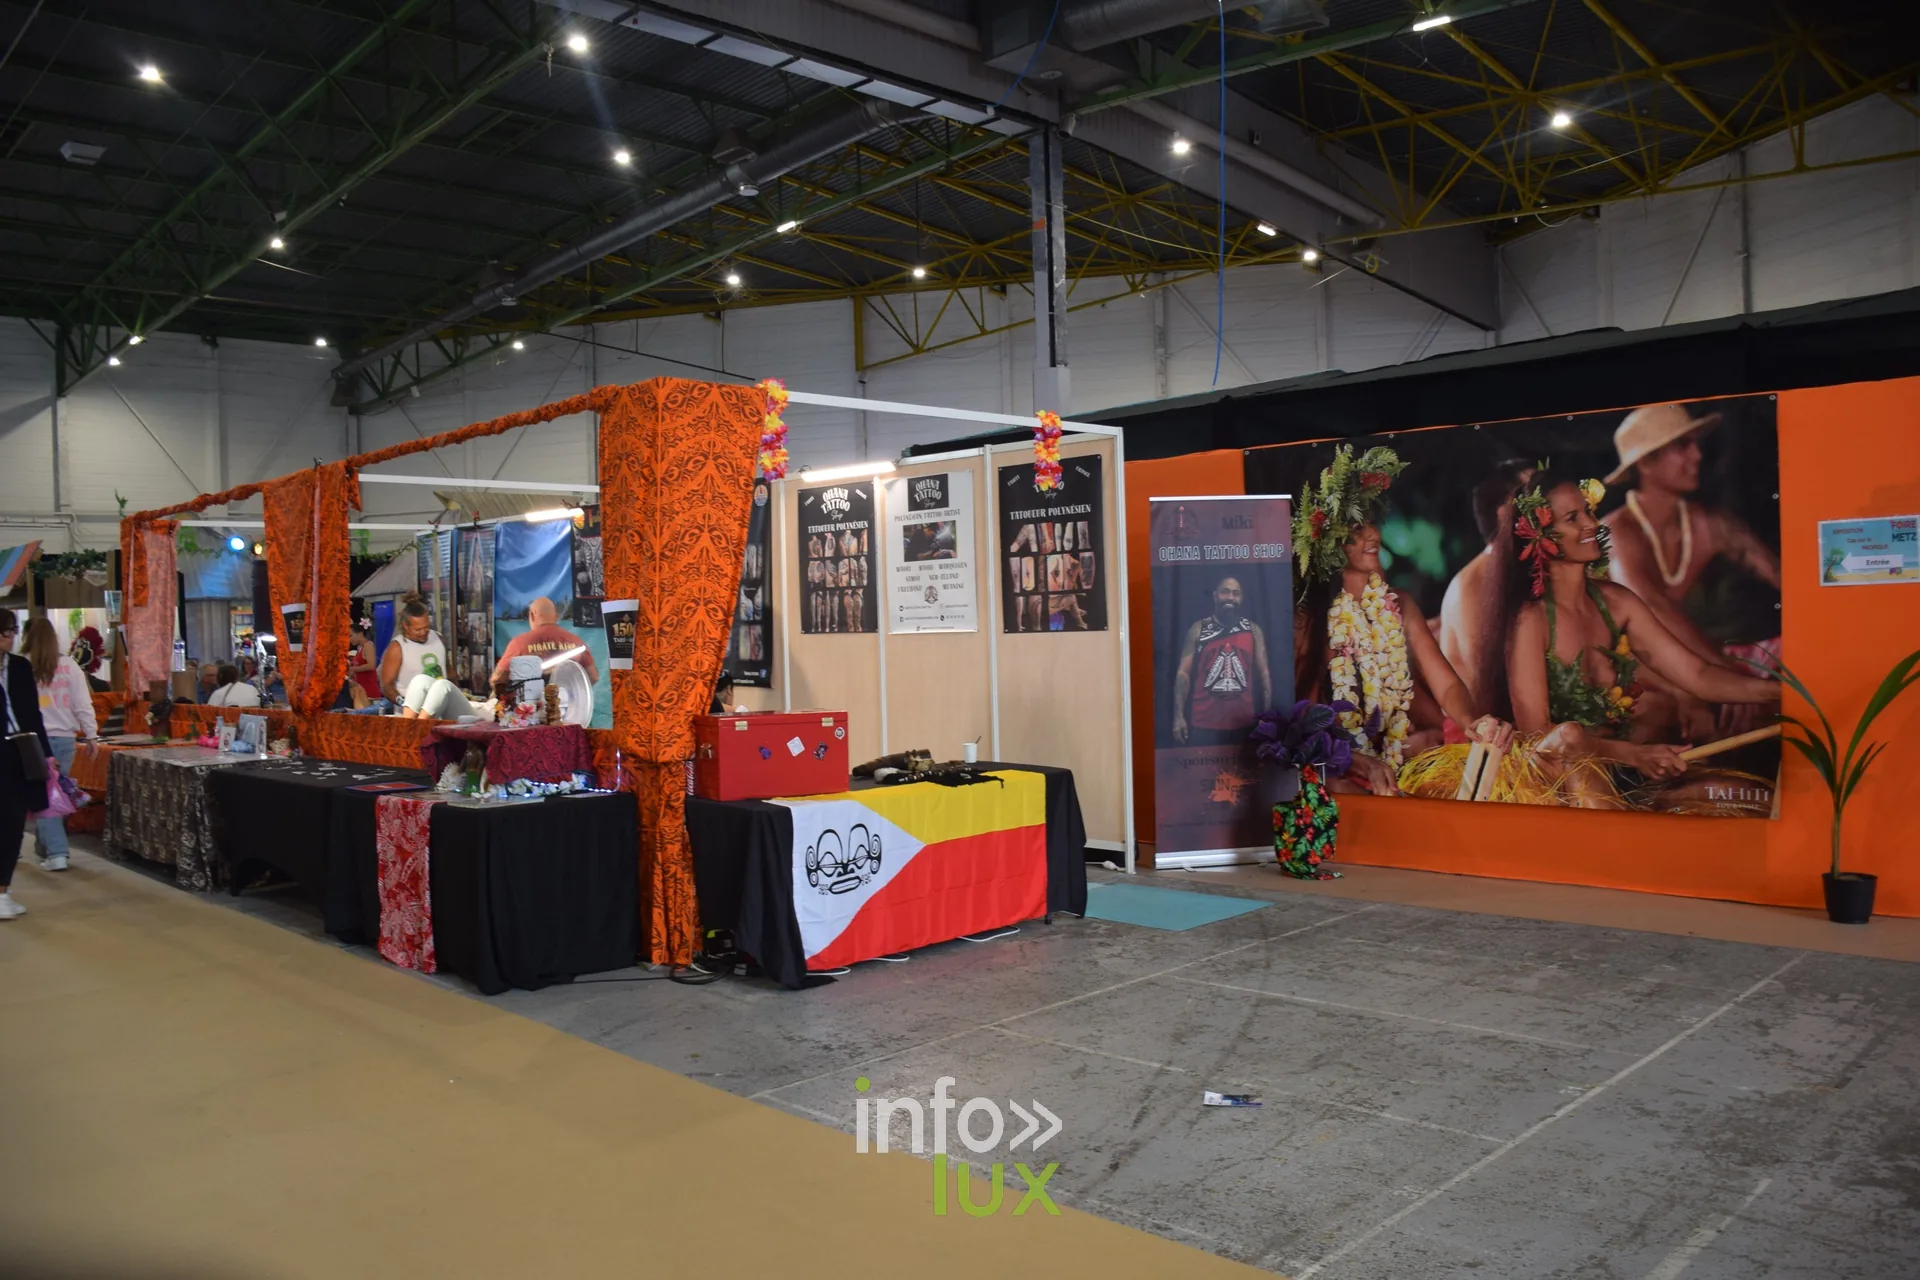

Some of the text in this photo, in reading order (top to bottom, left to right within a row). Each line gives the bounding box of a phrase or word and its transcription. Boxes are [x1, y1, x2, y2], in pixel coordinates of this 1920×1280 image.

[915, 479, 940, 492] OHANA
[822, 487, 849, 502] OHANA
[914, 488, 942, 502] TATTOO
[820, 498, 851, 514] TATTOO
[1009, 504, 1091, 520] TATOUEUR POLYNÉSIEN
[807, 520, 869, 534] TATOUEUR POLYNÉSIEN
[1890, 519, 1917, 529] FOIRE
[1891, 532, 1918, 542] METZ
[1159, 543, 1285, 561] OHANA TATTOO SHOP
[527, 641, 557, 653] PIRATE
[1704, 786, 1769, 802] TAHITI
